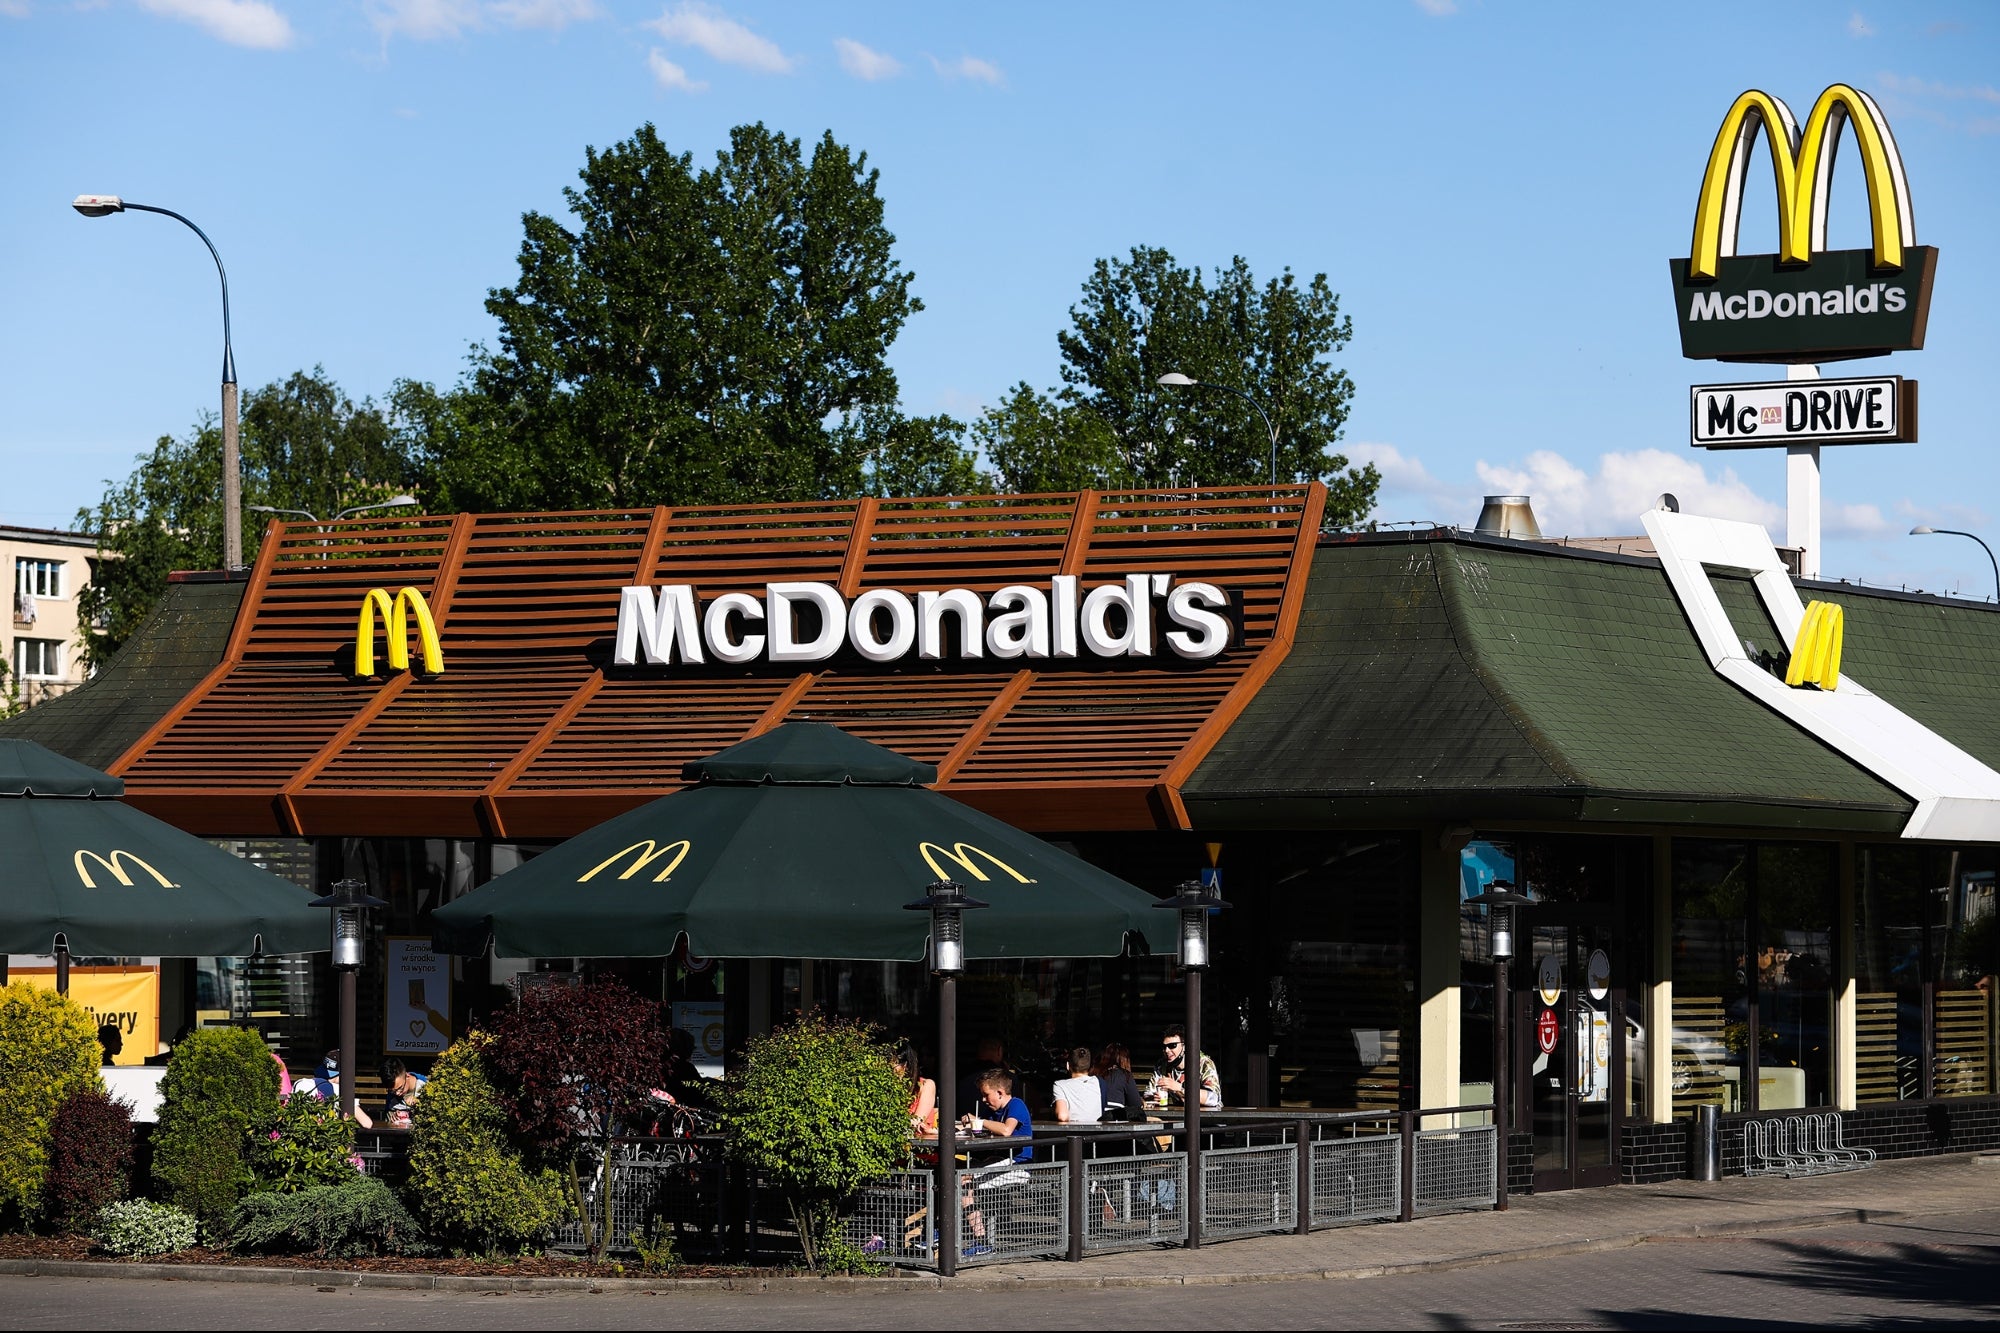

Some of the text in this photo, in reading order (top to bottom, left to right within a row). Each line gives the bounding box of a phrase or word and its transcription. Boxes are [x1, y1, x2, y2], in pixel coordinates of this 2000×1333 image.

[1688, 282, 1907, 322] McDonald's
[1707, 393, 1758, 436] Mc
[1785, 387, 1884, 432] DRIVE
[614, 573, 1232, 666] McDonald's
[395, 1039, 440, 1050] Zapraszamy
